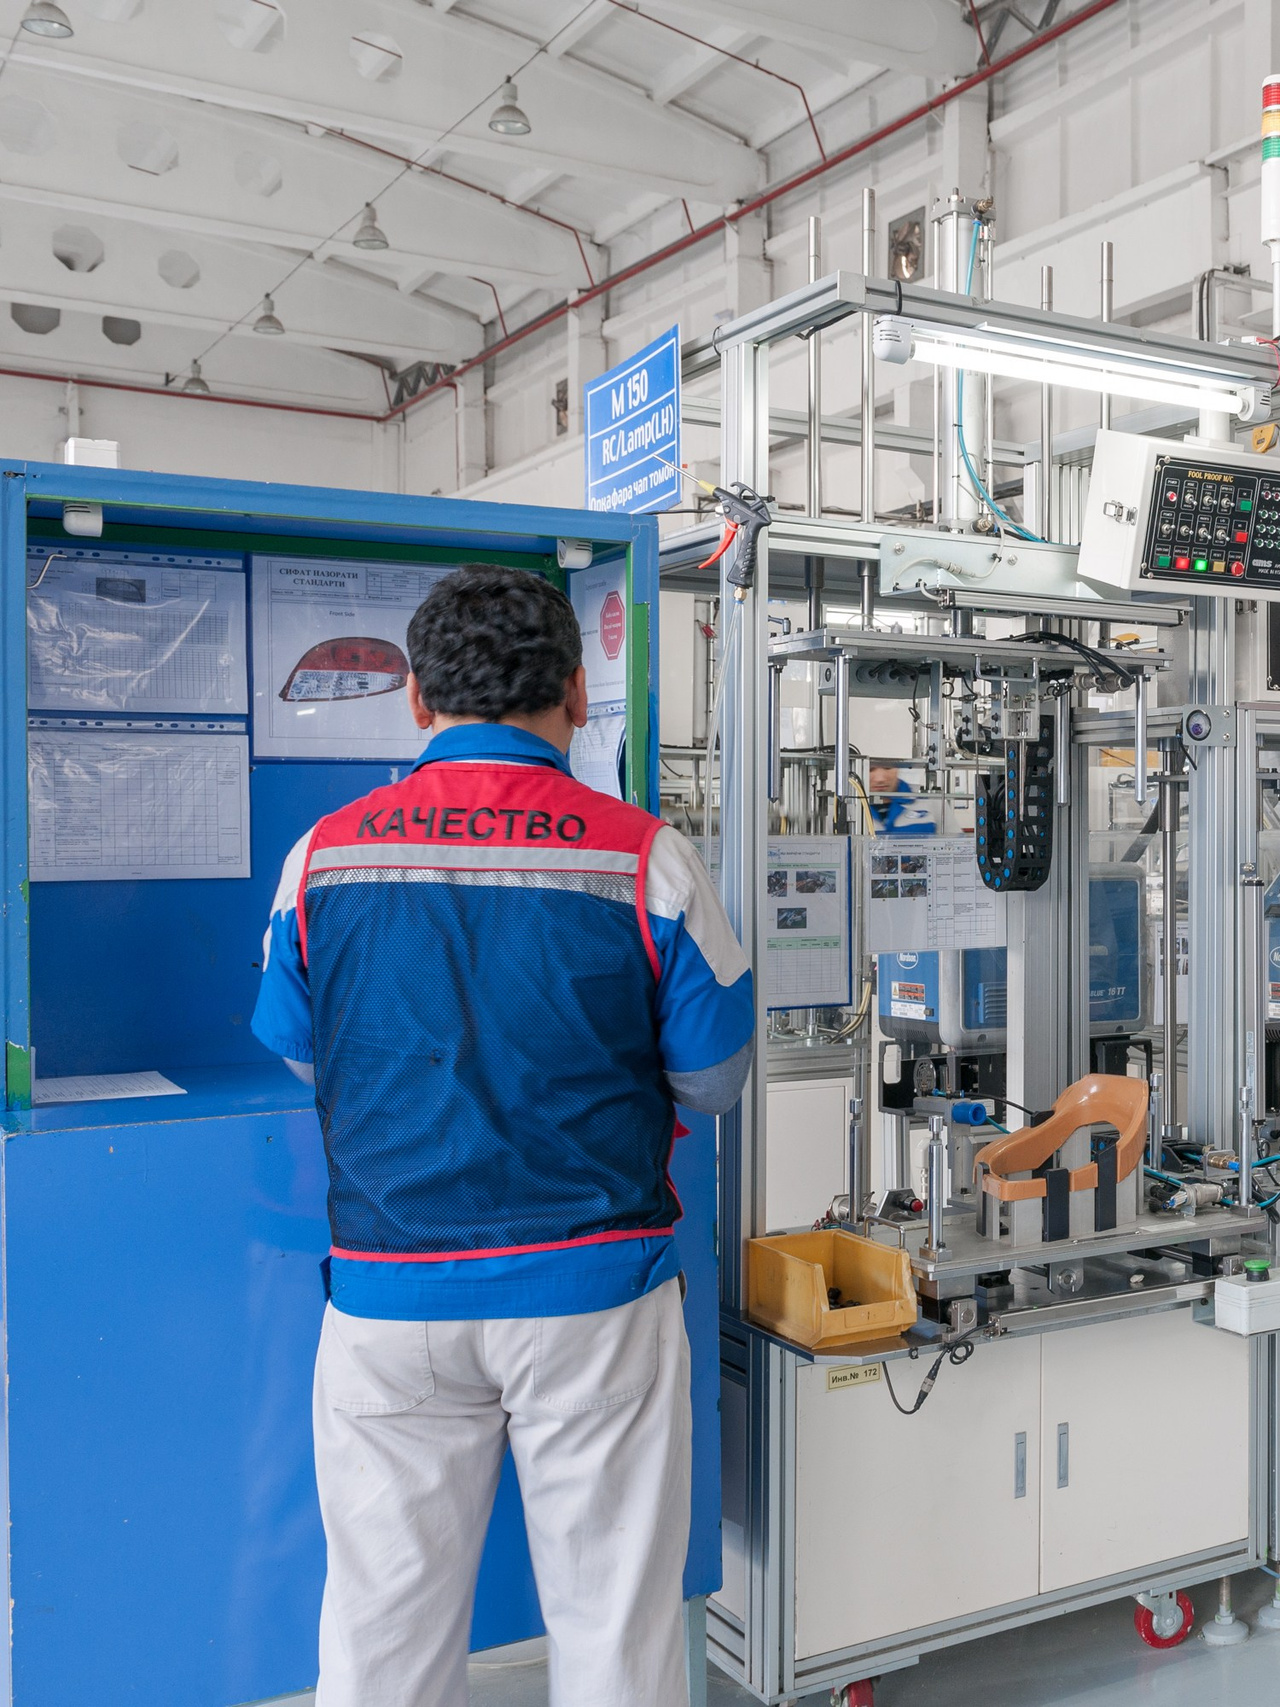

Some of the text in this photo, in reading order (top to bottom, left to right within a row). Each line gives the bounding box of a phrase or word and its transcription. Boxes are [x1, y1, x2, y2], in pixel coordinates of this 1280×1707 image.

[611, 368, 649, 420] M 150
[602, 403, 674, 466] RC/Lamp(LH)
[1188, 470, 1202, 479] FOOL
[1204, 472, 1222, 480] PROOF
[279, 568, 358, 579] СИФАТ НАЗОРАТИ
[293, 578, 345, 588] СТАНДАРТИ
[356, 806, 587, 842] КАЧЕСТВО
[864, 1368, 877, 1377] 172
